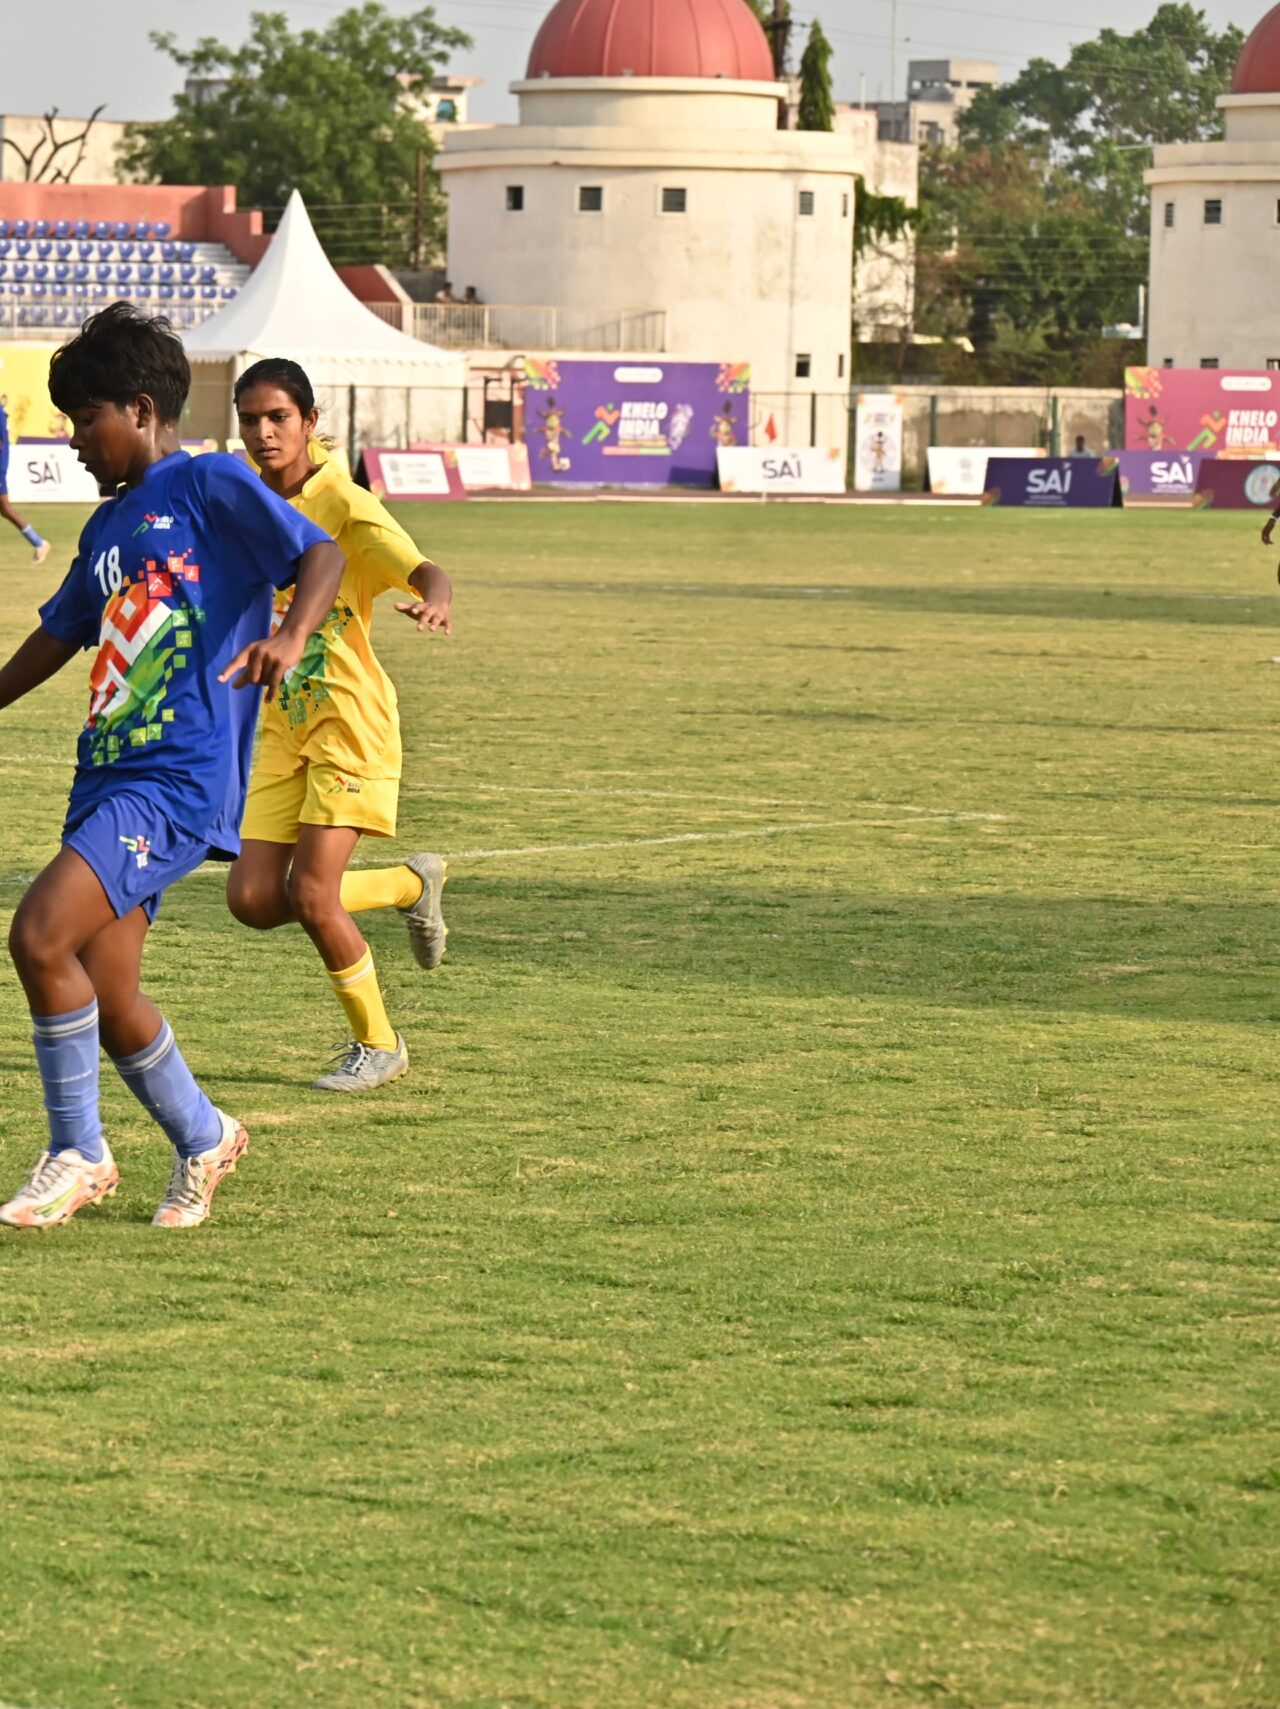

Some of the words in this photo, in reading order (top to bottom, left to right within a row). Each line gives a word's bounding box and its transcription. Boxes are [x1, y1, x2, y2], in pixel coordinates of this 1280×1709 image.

[621, 401, 668, 420] KHELO
[1228, 409, 1278, 428] KHELO
[618, 419, 660, 438] INDIA
[1225, 426, 1269, 444] INDIA
[27, 453, 62, 484] SAI
[762, 452, 802, 479] SAI
[1026, 462, 1072, 493] SAI
[1150, 455, 1193, 484] SAI
[94, 545, 122, 596] 18
